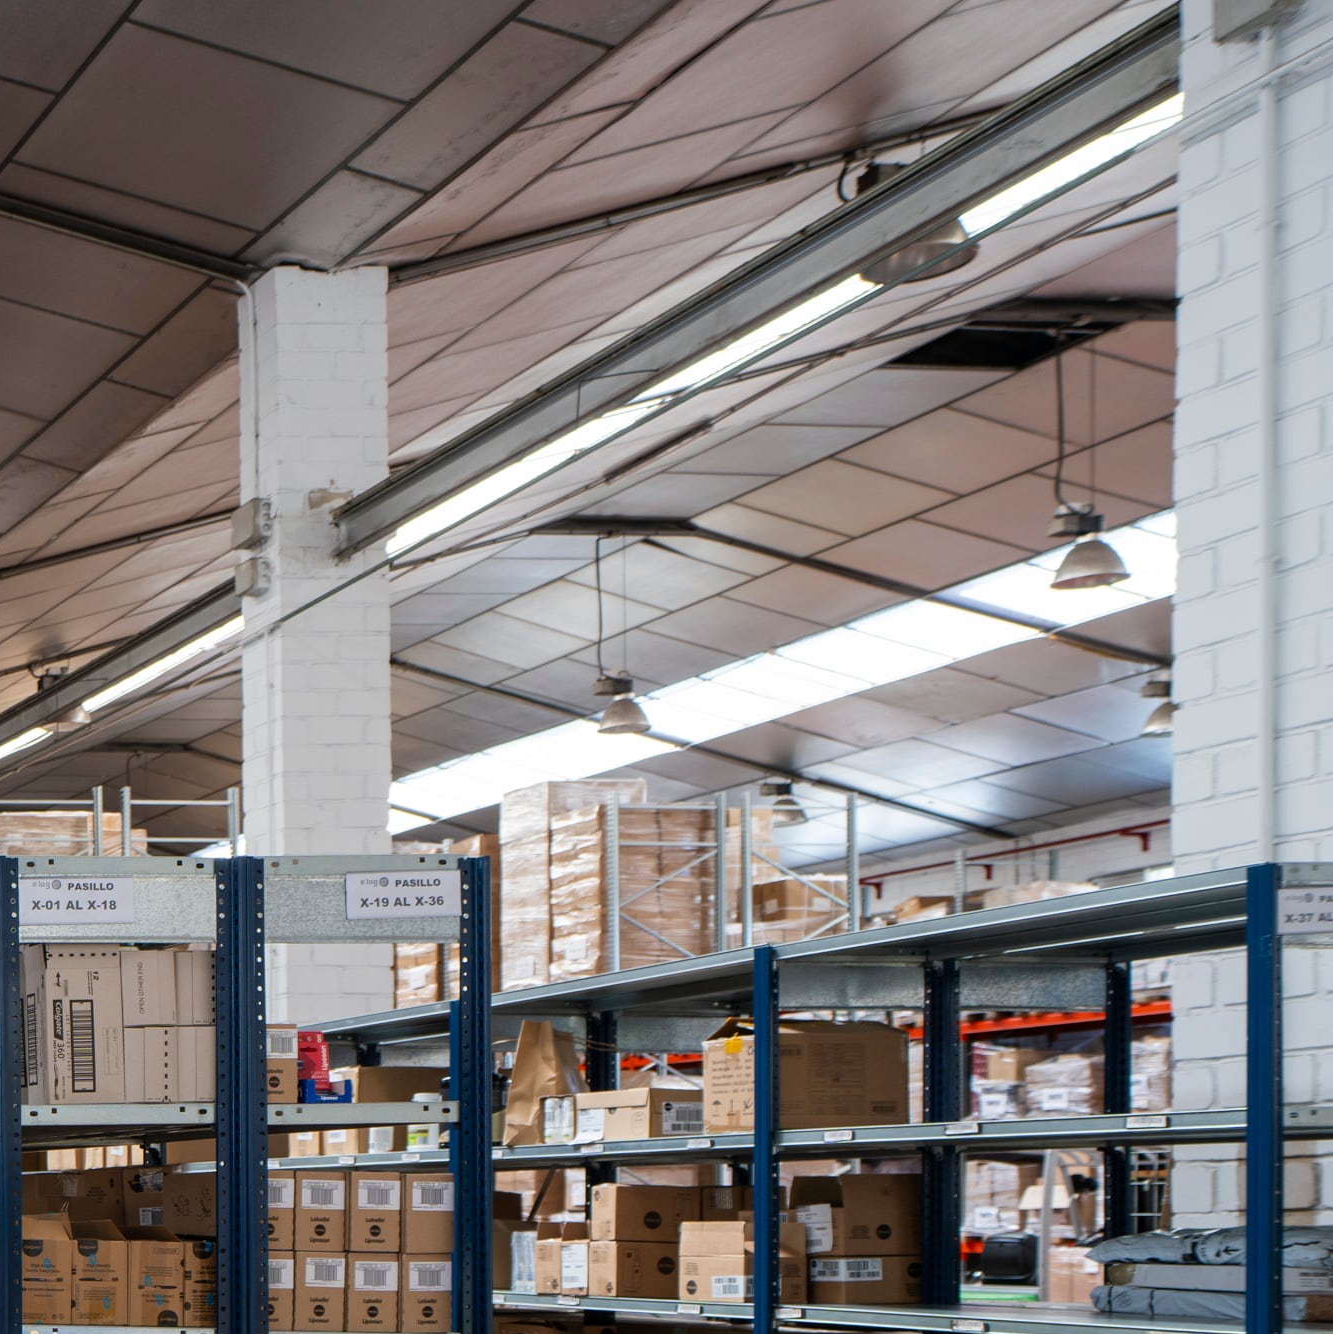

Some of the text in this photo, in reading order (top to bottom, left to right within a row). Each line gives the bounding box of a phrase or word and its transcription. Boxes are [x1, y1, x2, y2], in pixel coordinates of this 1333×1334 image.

[67, 881, 114, 891] PASILLO
[394, 878, 440, 888] PASILLO
[31, 900, 117, 910] X-01 AL X-18
[360, 896, 444, 908] X-19 AL X-36
[92, 971, 99, 981] 12
[55, 1002, 63, 1038] Colgate
